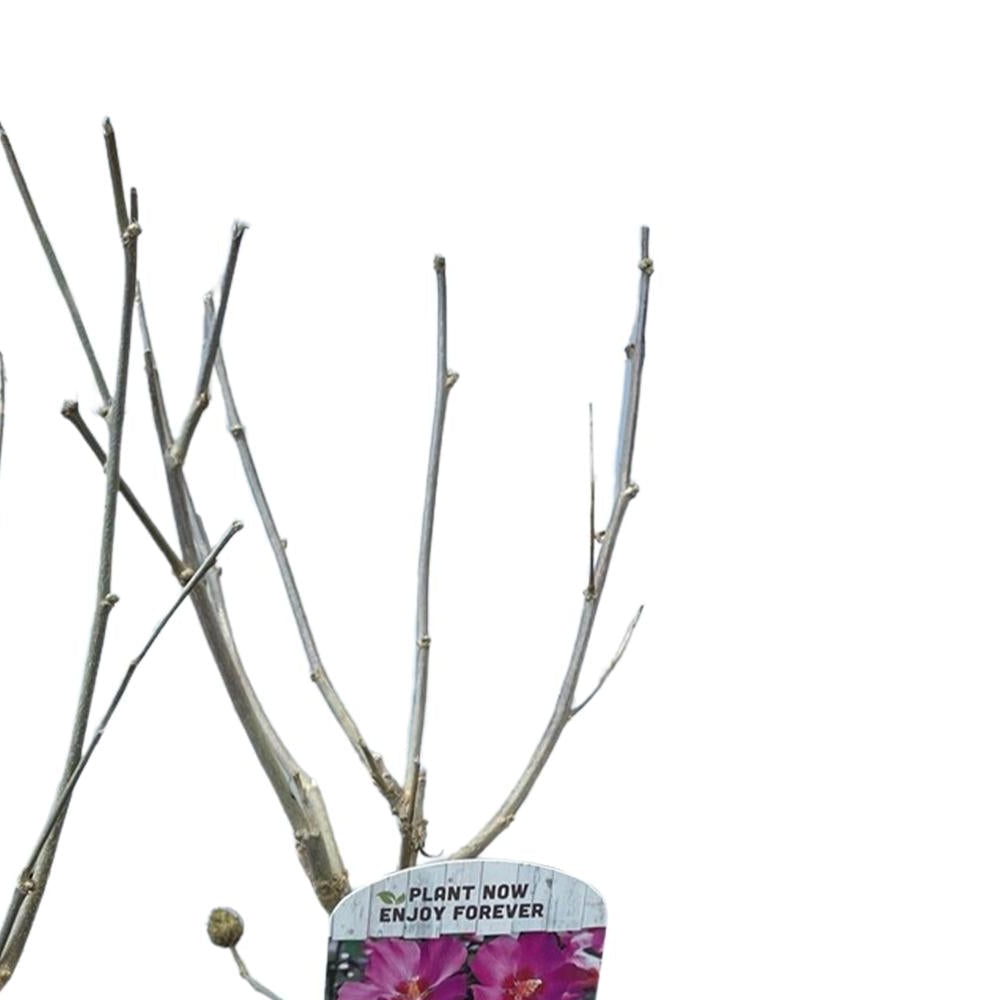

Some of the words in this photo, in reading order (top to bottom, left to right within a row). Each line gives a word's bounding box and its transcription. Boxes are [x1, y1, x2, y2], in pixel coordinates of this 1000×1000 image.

[409, 885, 475, 902] PLANT
[483, 884, 529, 900] NOW
[379, 905, 446, 923] ENJOY
[452, 903, 544, 921] FOREVER
